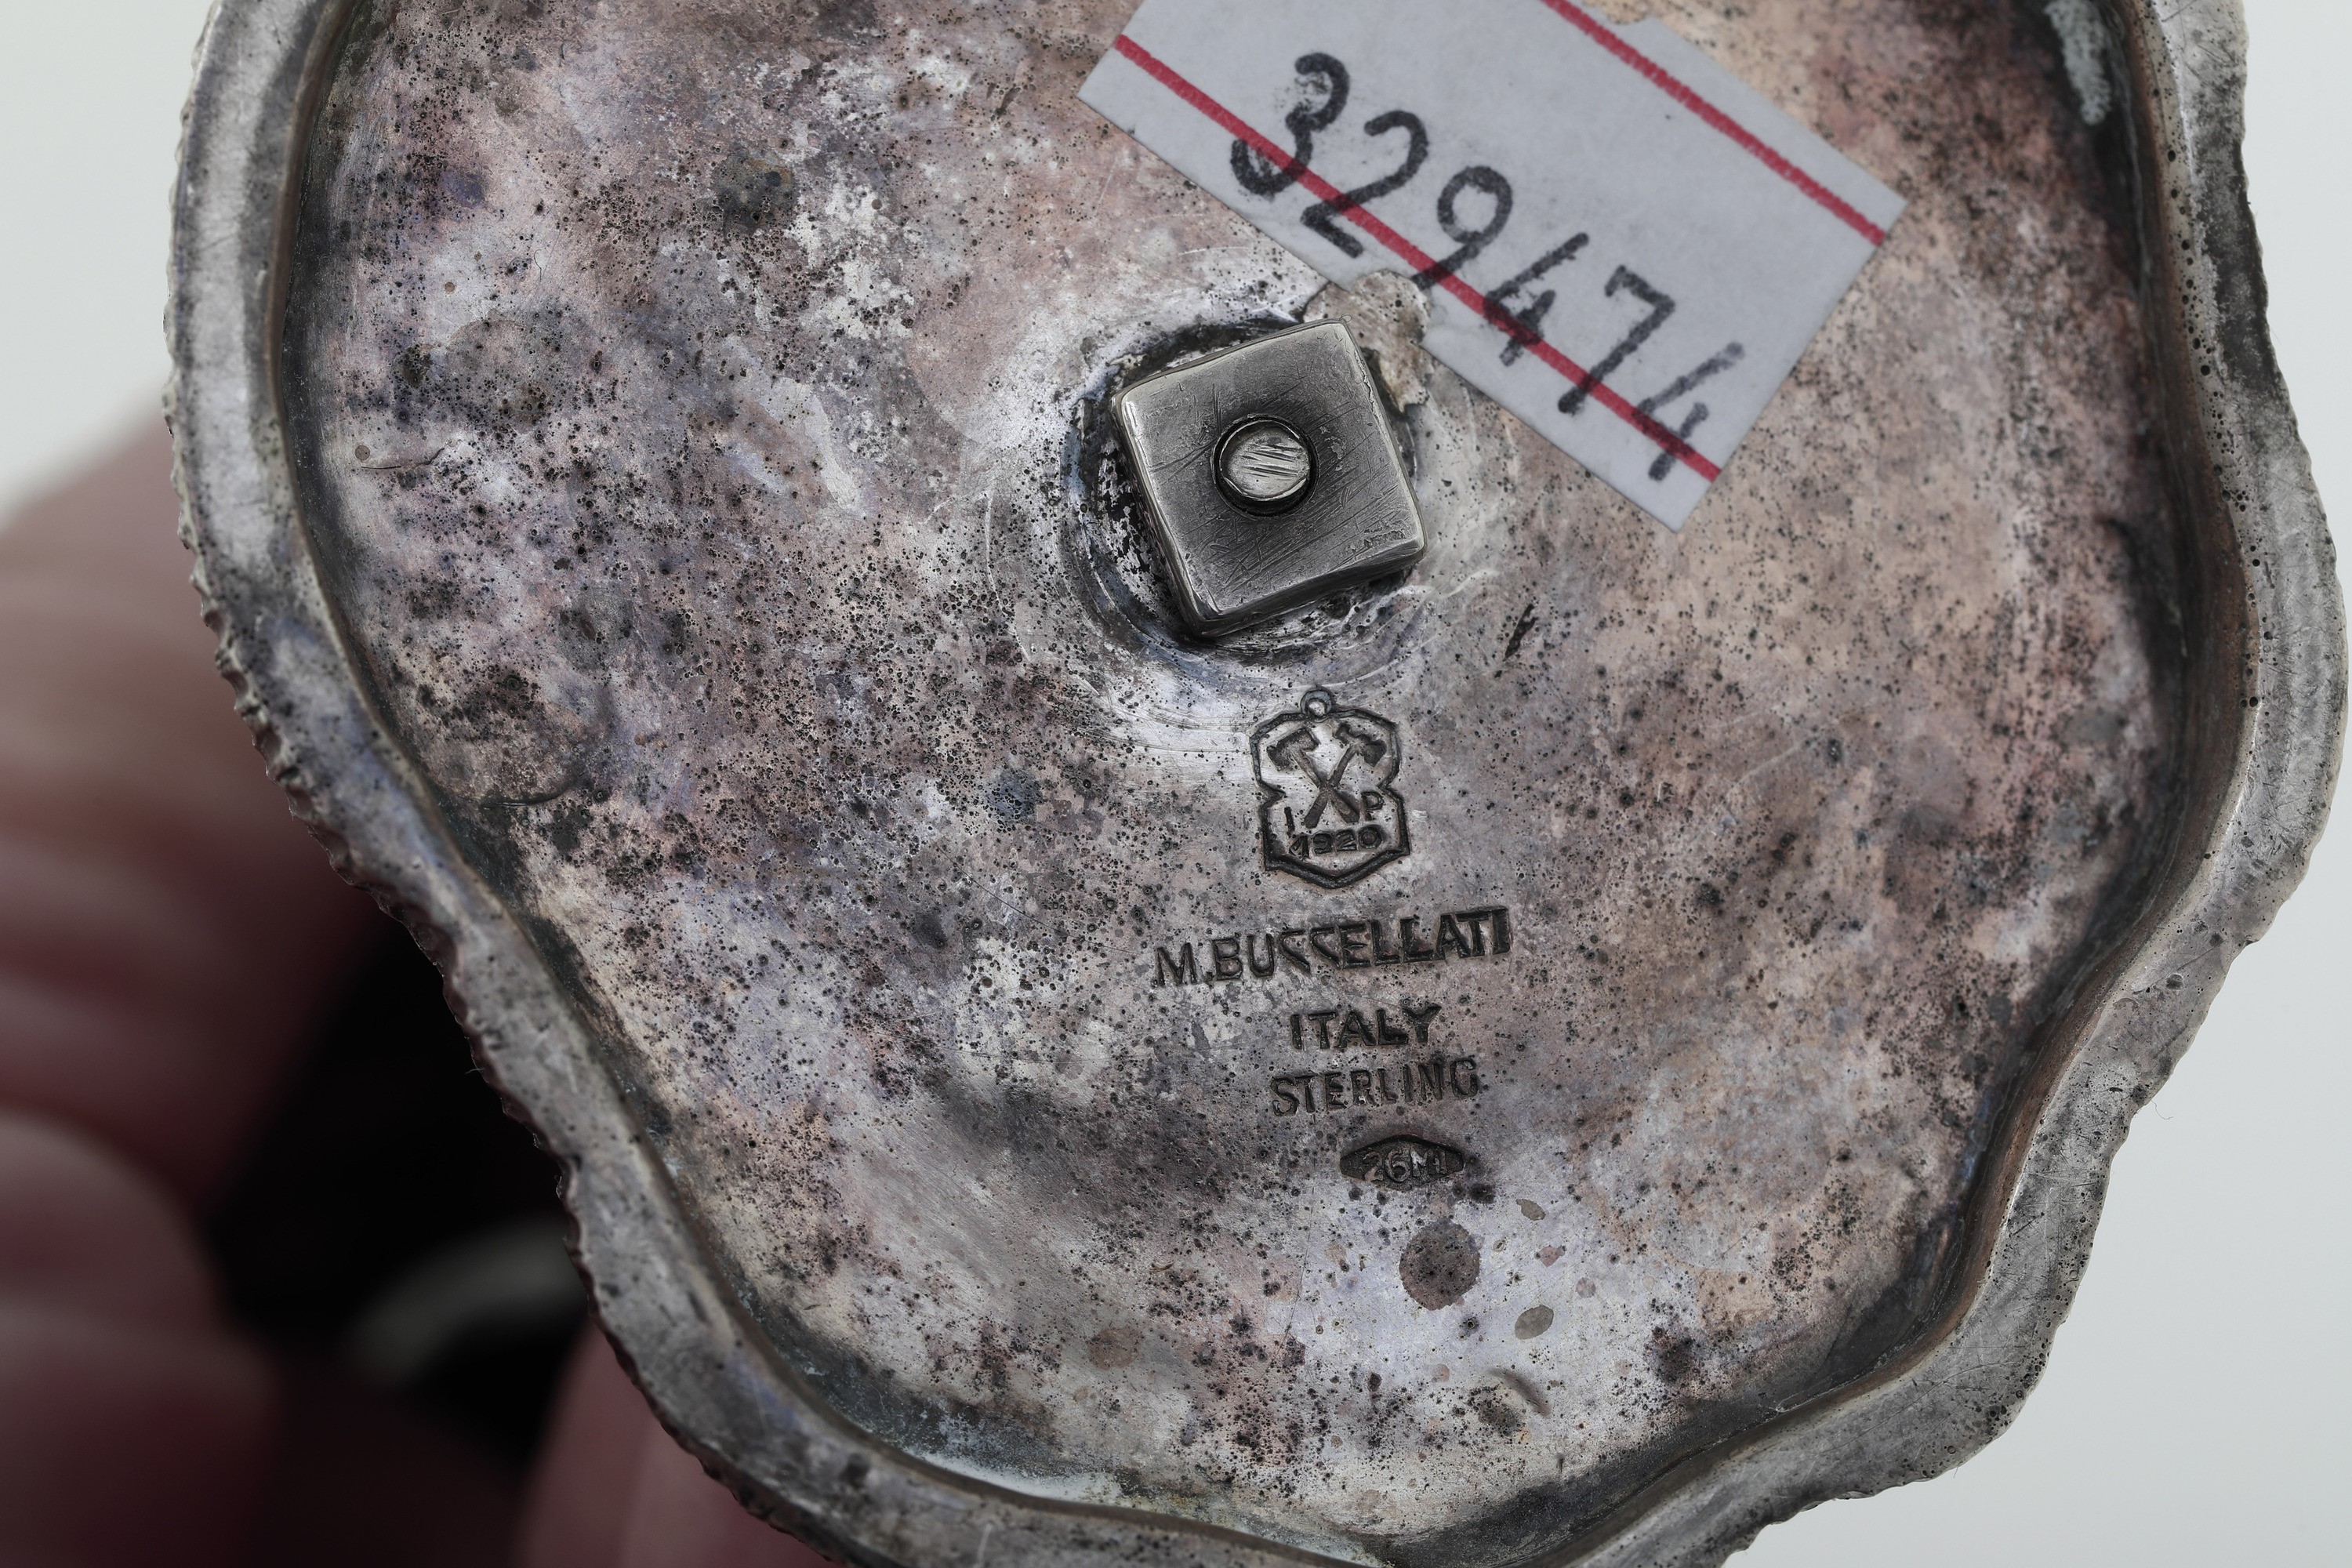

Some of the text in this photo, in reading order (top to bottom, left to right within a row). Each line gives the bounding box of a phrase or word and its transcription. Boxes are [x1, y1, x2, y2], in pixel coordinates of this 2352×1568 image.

[1230, 53, 1745, 481] 329474
[1289, 1003, 1442, 1050] ITALY
[1271, 1058, 1480, 1116] STERLING
